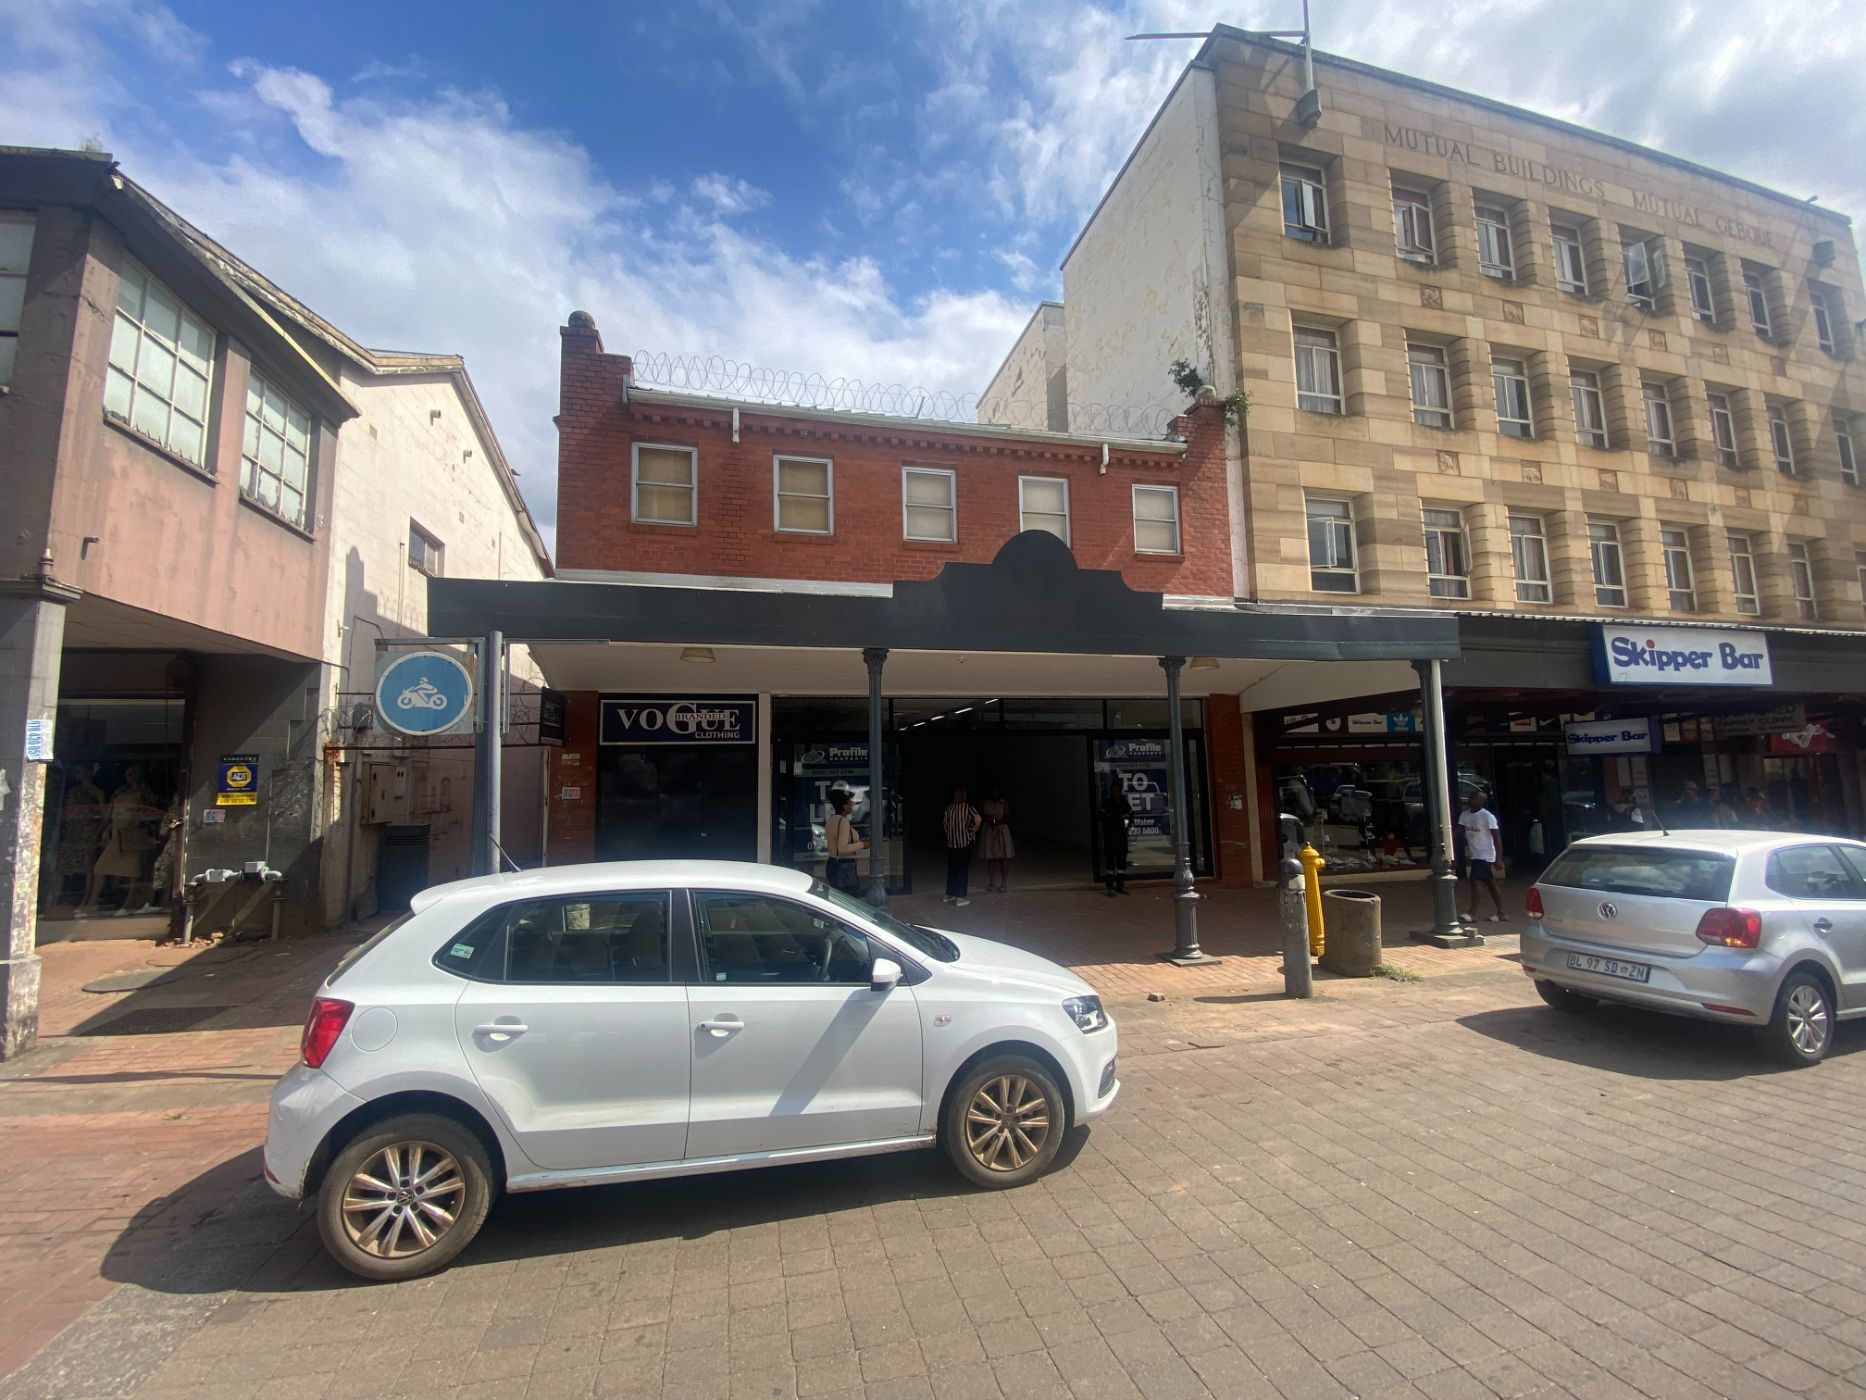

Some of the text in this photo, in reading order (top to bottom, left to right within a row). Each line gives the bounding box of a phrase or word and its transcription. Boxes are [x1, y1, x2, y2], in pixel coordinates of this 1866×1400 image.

[1384, 125, 1776, 249] MUTUAL BUILDINGS MUTUAL GEBOUE
[1611, 636, 1764, 671] Skipper Bar
[616, 703, 741, 735] VOGUE
[674, 712, 727, 721] BRANDED
[695, 731, 741, 739] CLOTHING
[1568, 730, 1648, 745] Skipper Bar
[829, 747, 869, 757] Profile
[1129, 744, 1162, 752] Profile
[1119, 773, 1148, 791] TO
[1127, 793, 1155, 811] ET
[1570, 955, 1645, 979] BL 97 SD ZN
